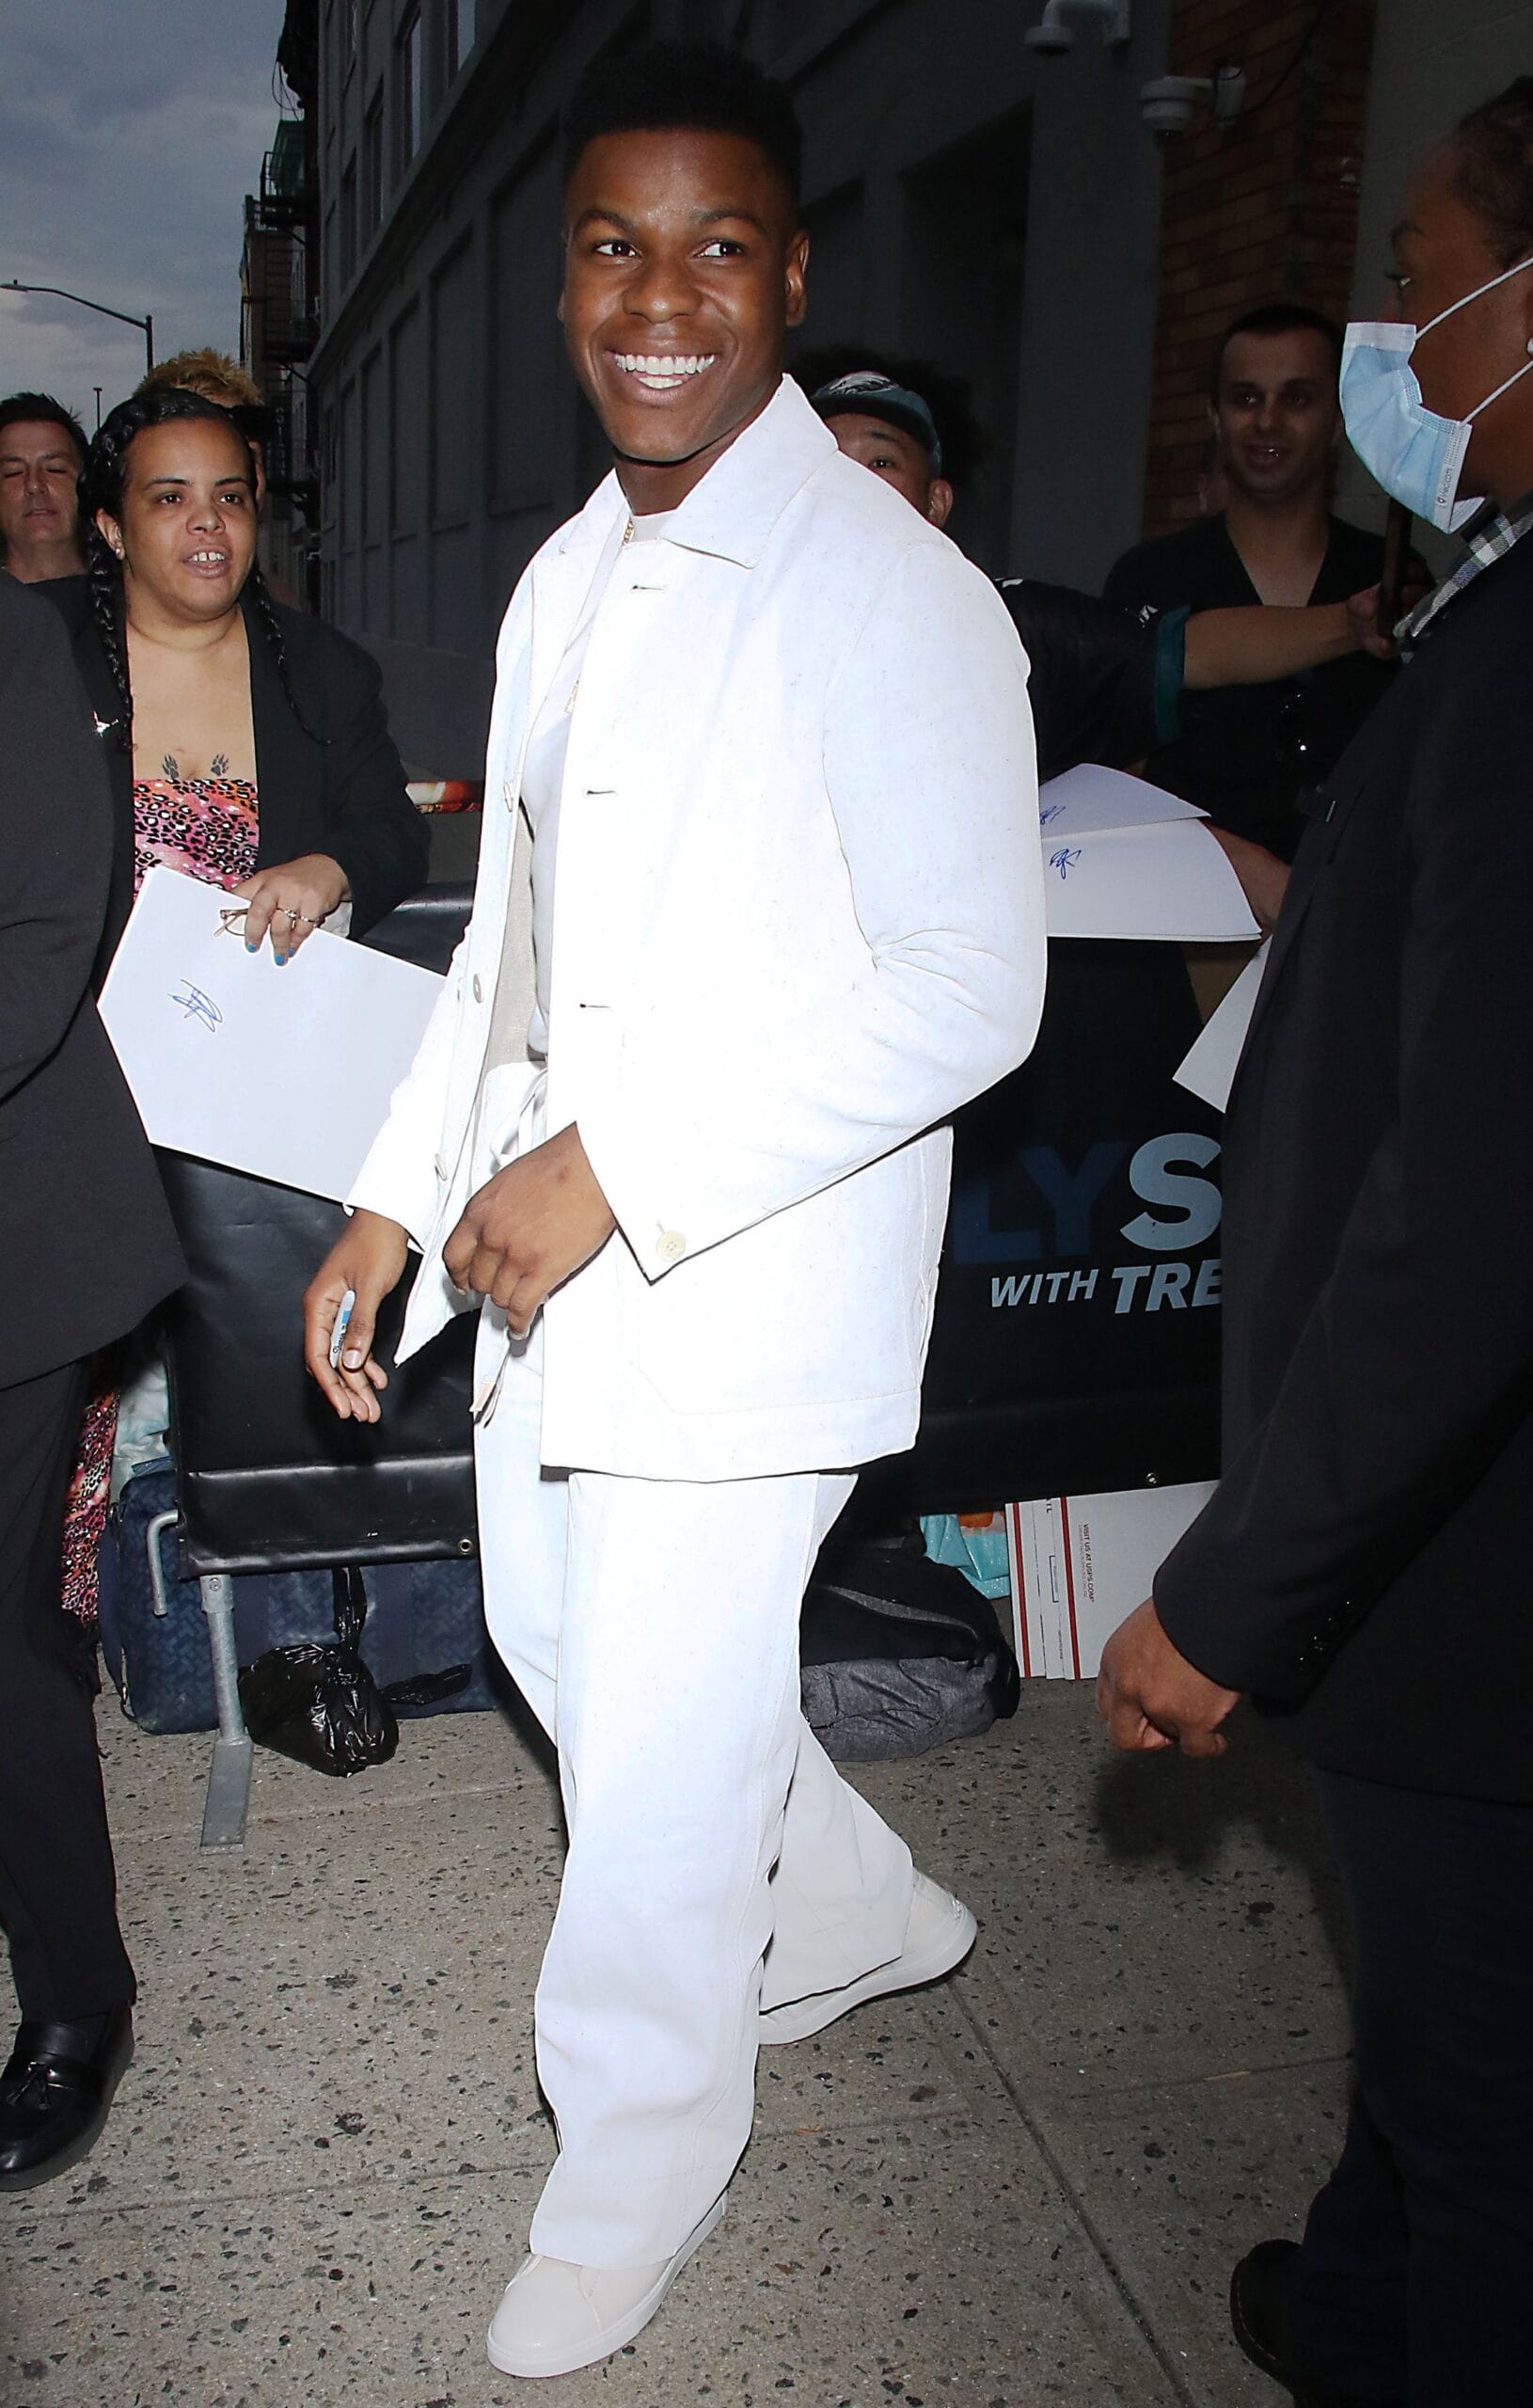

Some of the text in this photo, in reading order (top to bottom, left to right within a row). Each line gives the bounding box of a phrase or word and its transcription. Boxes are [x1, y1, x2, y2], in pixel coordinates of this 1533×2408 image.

[990, 1259, 1223, 1316] WITH TRE
[1084, 1542, 1091, 1552] US
[1086, 1553, 1092, 1561] AT
